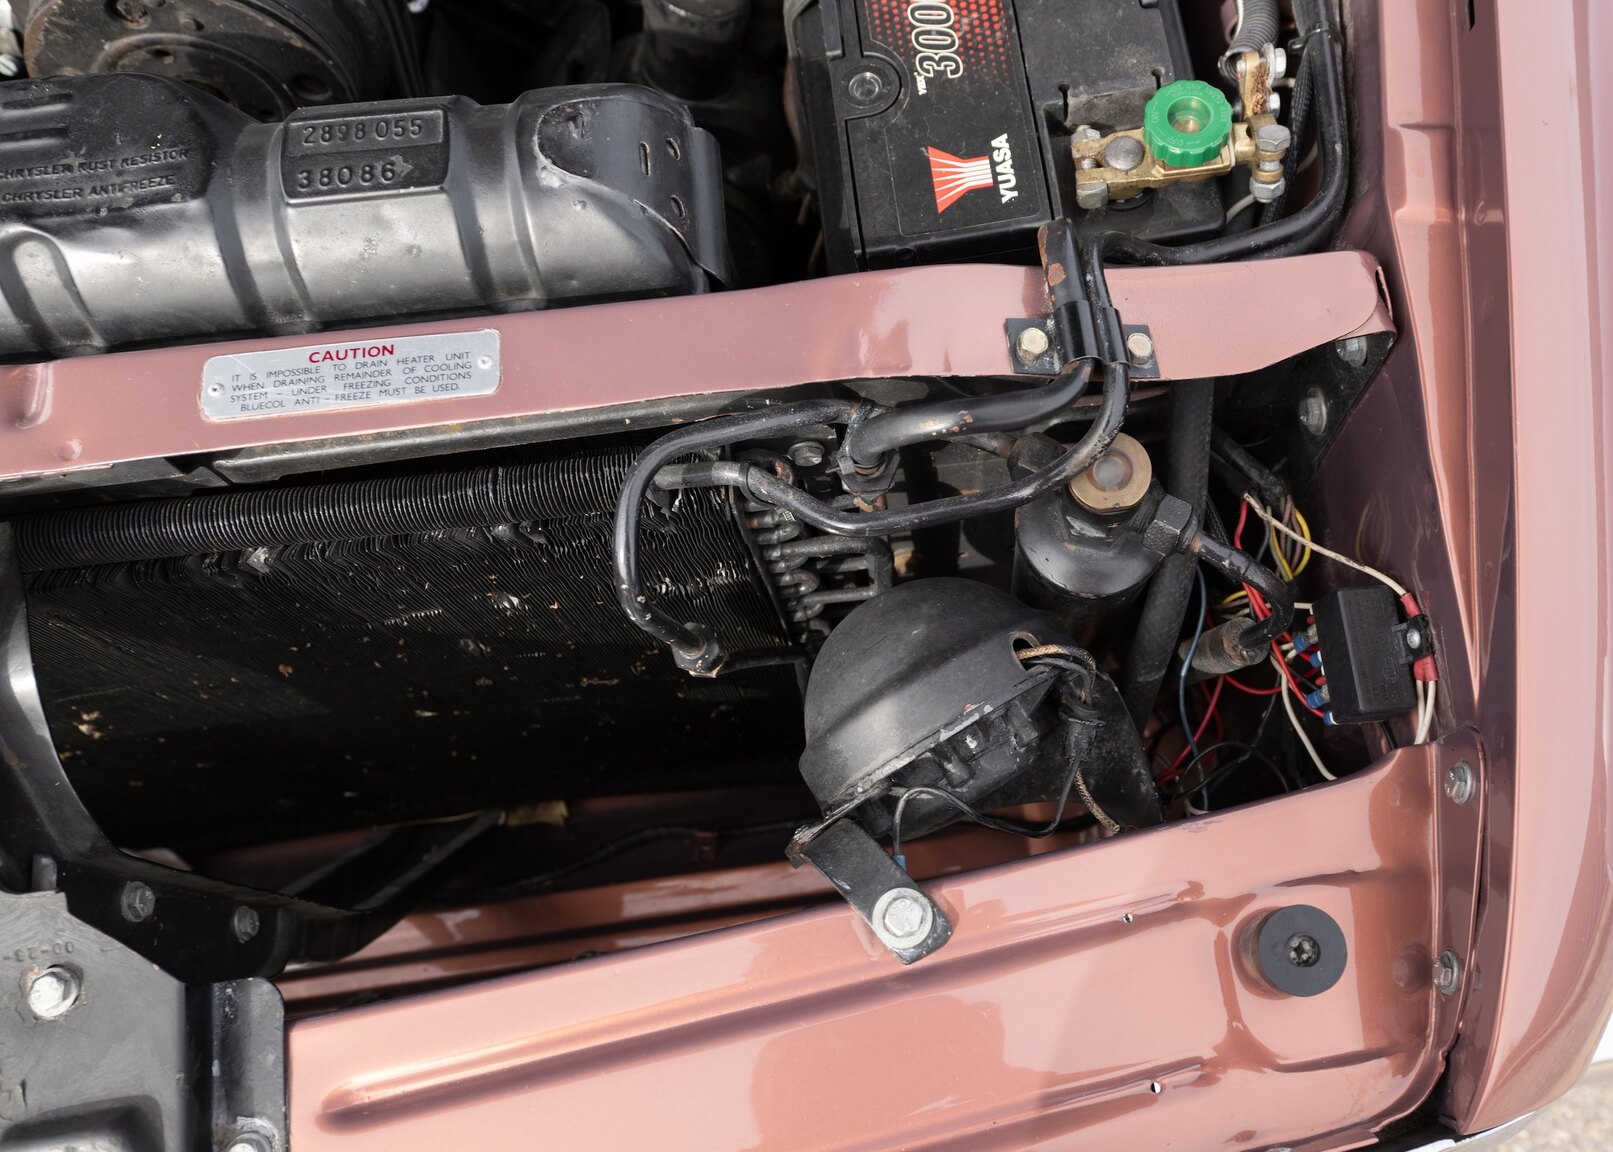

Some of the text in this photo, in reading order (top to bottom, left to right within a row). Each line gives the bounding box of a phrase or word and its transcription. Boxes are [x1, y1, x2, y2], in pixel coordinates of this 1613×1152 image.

[907, 0, 963, 79] 300
[77, 158, 117, 174] RUST
[120, 148, 190, 169] RESISTOR
[298, 161, 397, 189] 38086
[991, 133, 1018, 203] YUASA
[2, 187, 84, 202] CHRYSLER
[232, 351, 471, 382] IT IS IMPOSSIBLE TO DRAIN HEATER UNIT
[308, 344, 394, 364] CAUTION
[230, 391, 268, 403] SYSTEM
[291, 385, 327, 396] UNDER
[343, 379, 392, 391] FREEZING
[404, 371, 472, 385] CONDITIONS
[232, 361, 472, 392] WHEN DRAINING REMAINDER OF COOLING
[240, 399, 286, 412] BLUECOL
[293, 396, 320, 406] ANTI
[335, 391, 371, 401] FREEZE
[379, 386, 407, 397] MUST
[414, 385, 426, 394] BE
